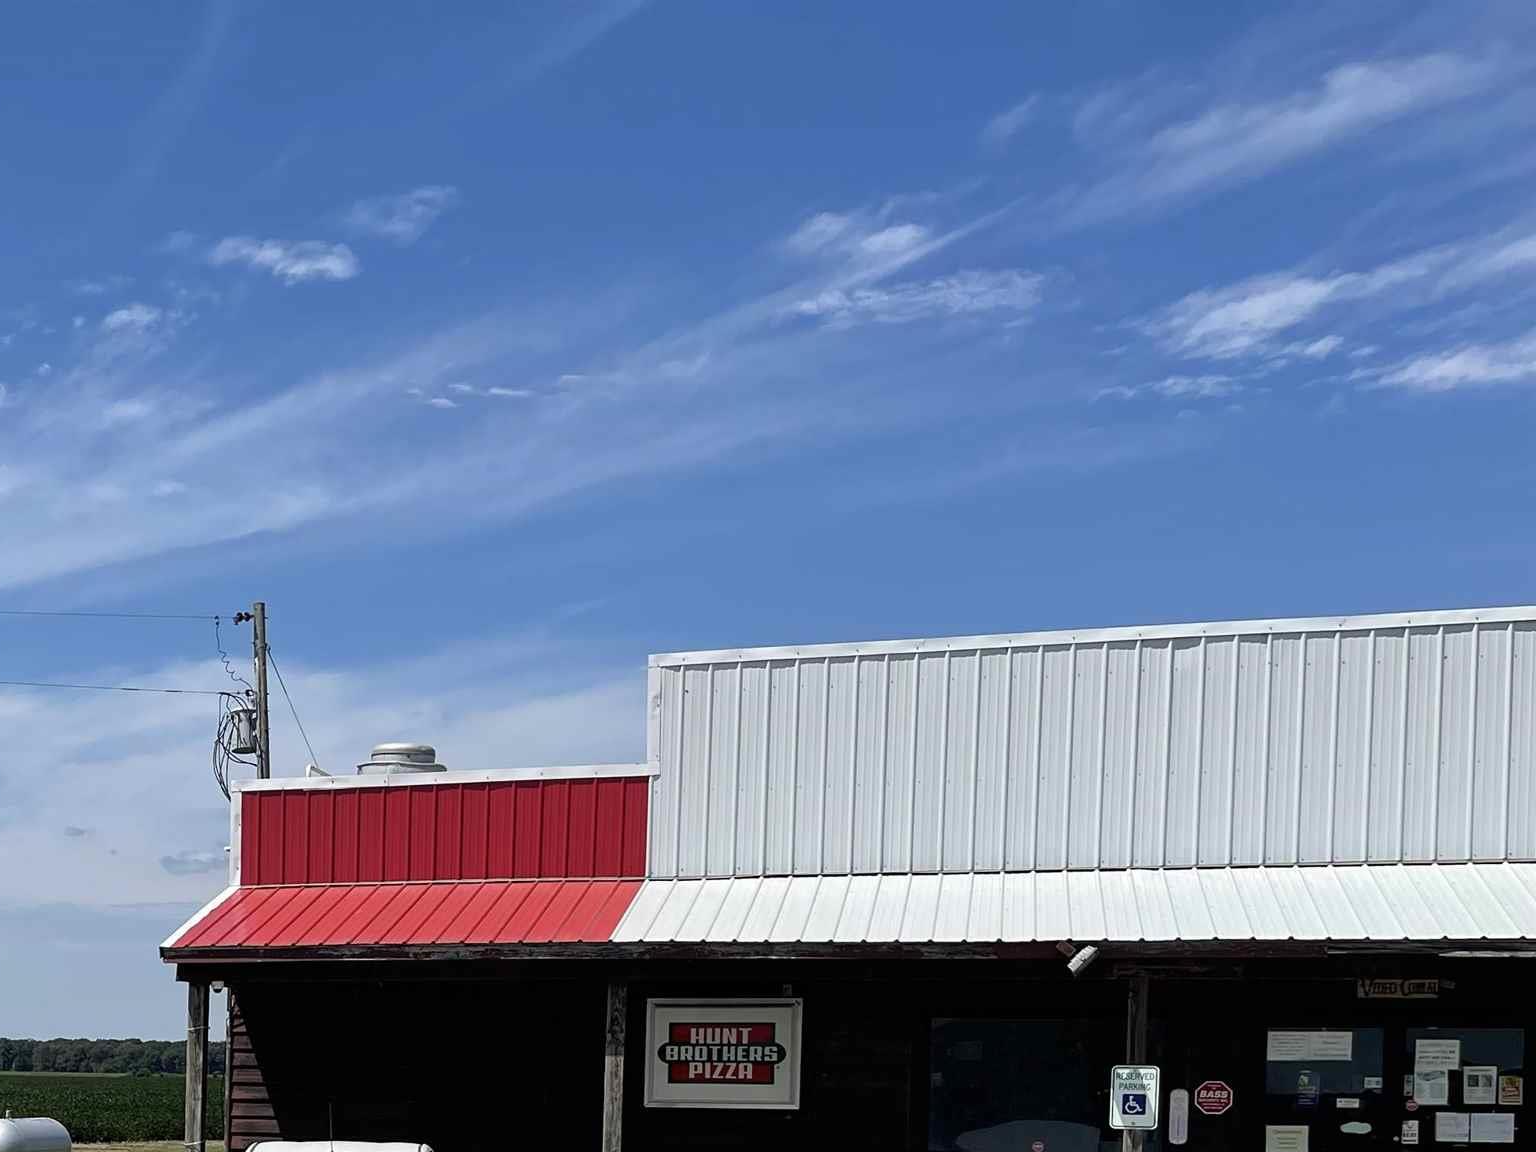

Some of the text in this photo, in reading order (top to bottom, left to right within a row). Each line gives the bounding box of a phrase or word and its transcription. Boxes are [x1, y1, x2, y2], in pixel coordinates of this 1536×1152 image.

[690, 1027, 752, 1044] HUNT
[665, 1045, 778, 1062] BROTHERS
[688, 1062, 753, 1079] PIZZA
[1116, 1072, 1155, 1081] RESERVED
[1119, 1082, 1151, 1091] PARKING
[1200, 1089, 1229, 1098] BASS
